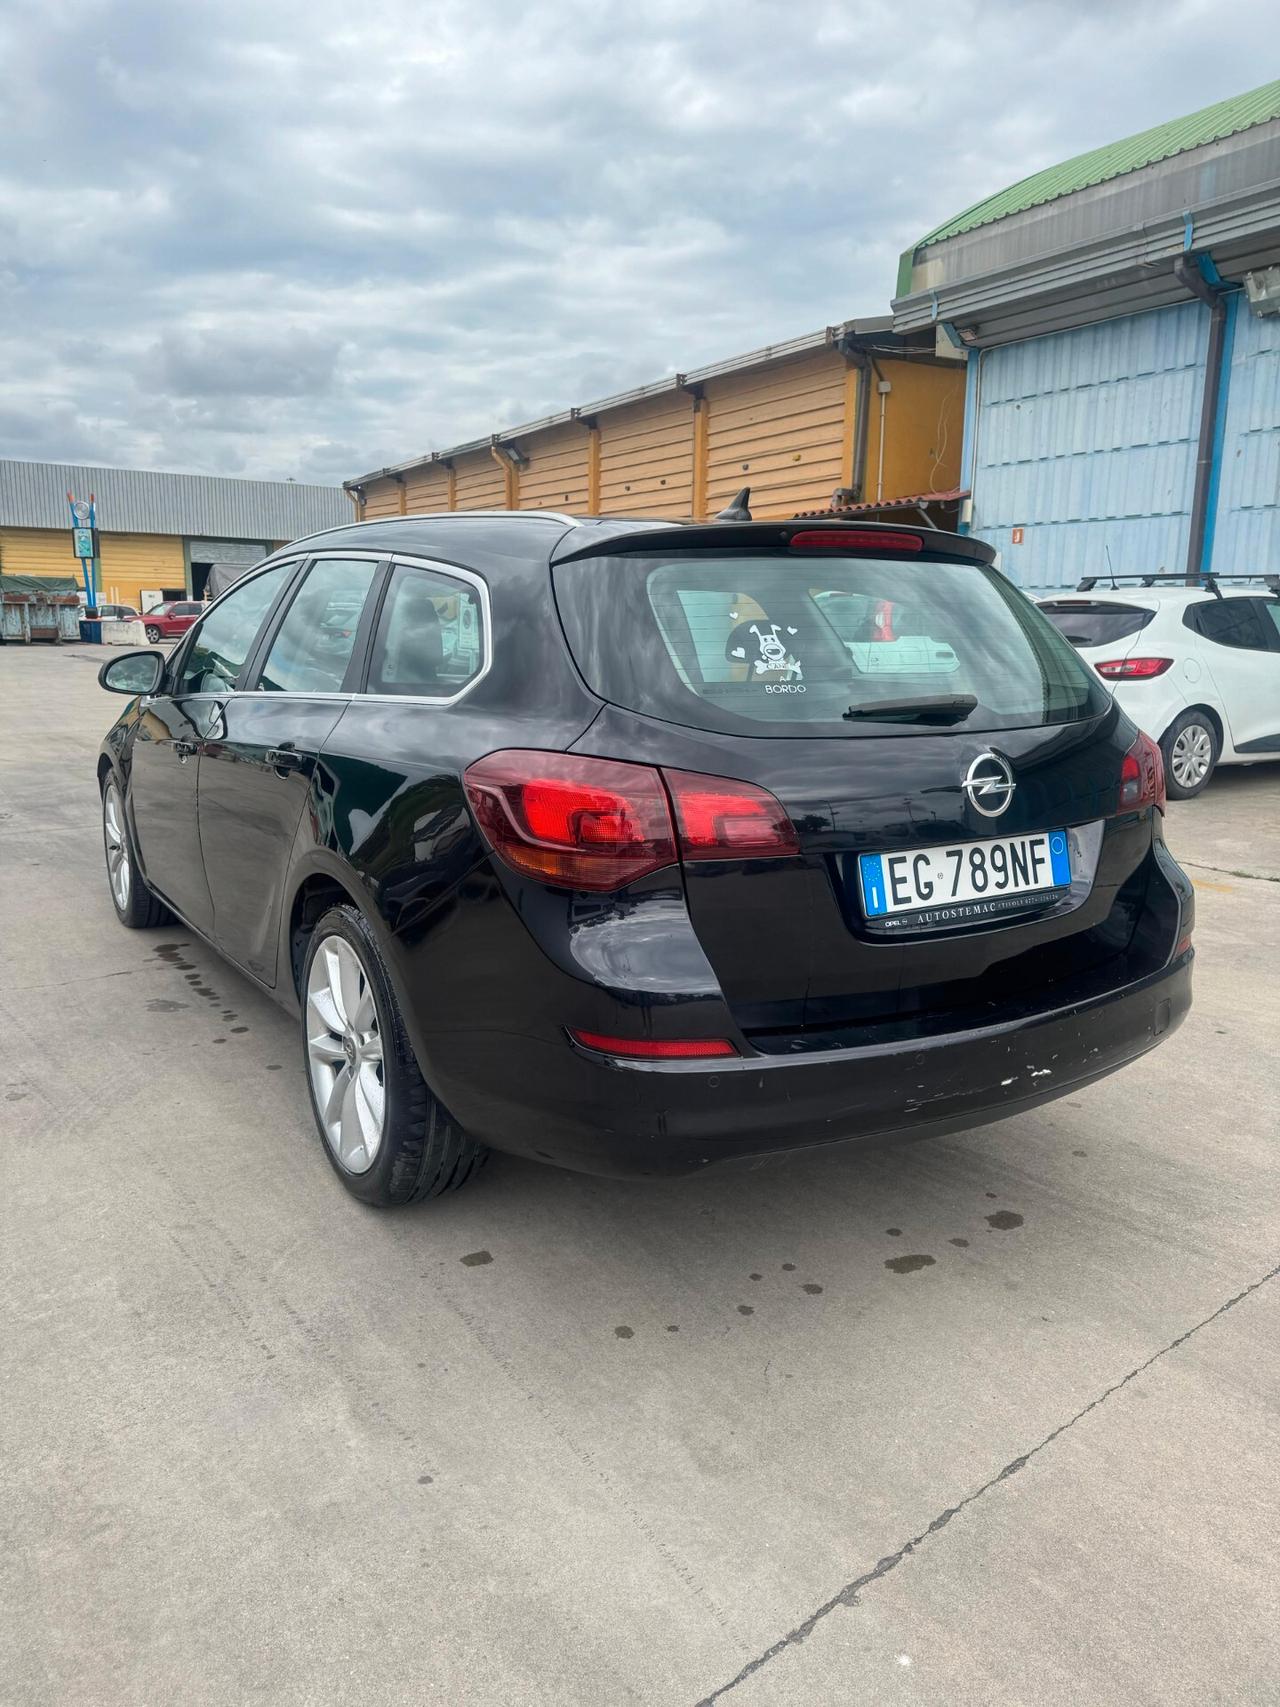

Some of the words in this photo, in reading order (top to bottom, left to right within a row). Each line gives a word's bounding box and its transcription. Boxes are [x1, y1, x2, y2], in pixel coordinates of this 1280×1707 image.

[765, 685, 806, 694] BORDO
[888, 853, 934, 906] EG
[946, 838, 1046, 897] 789NF
[885, 919, 901, 928] OPEL
[917, 902, 997, 924] AUTOSTEMAC
